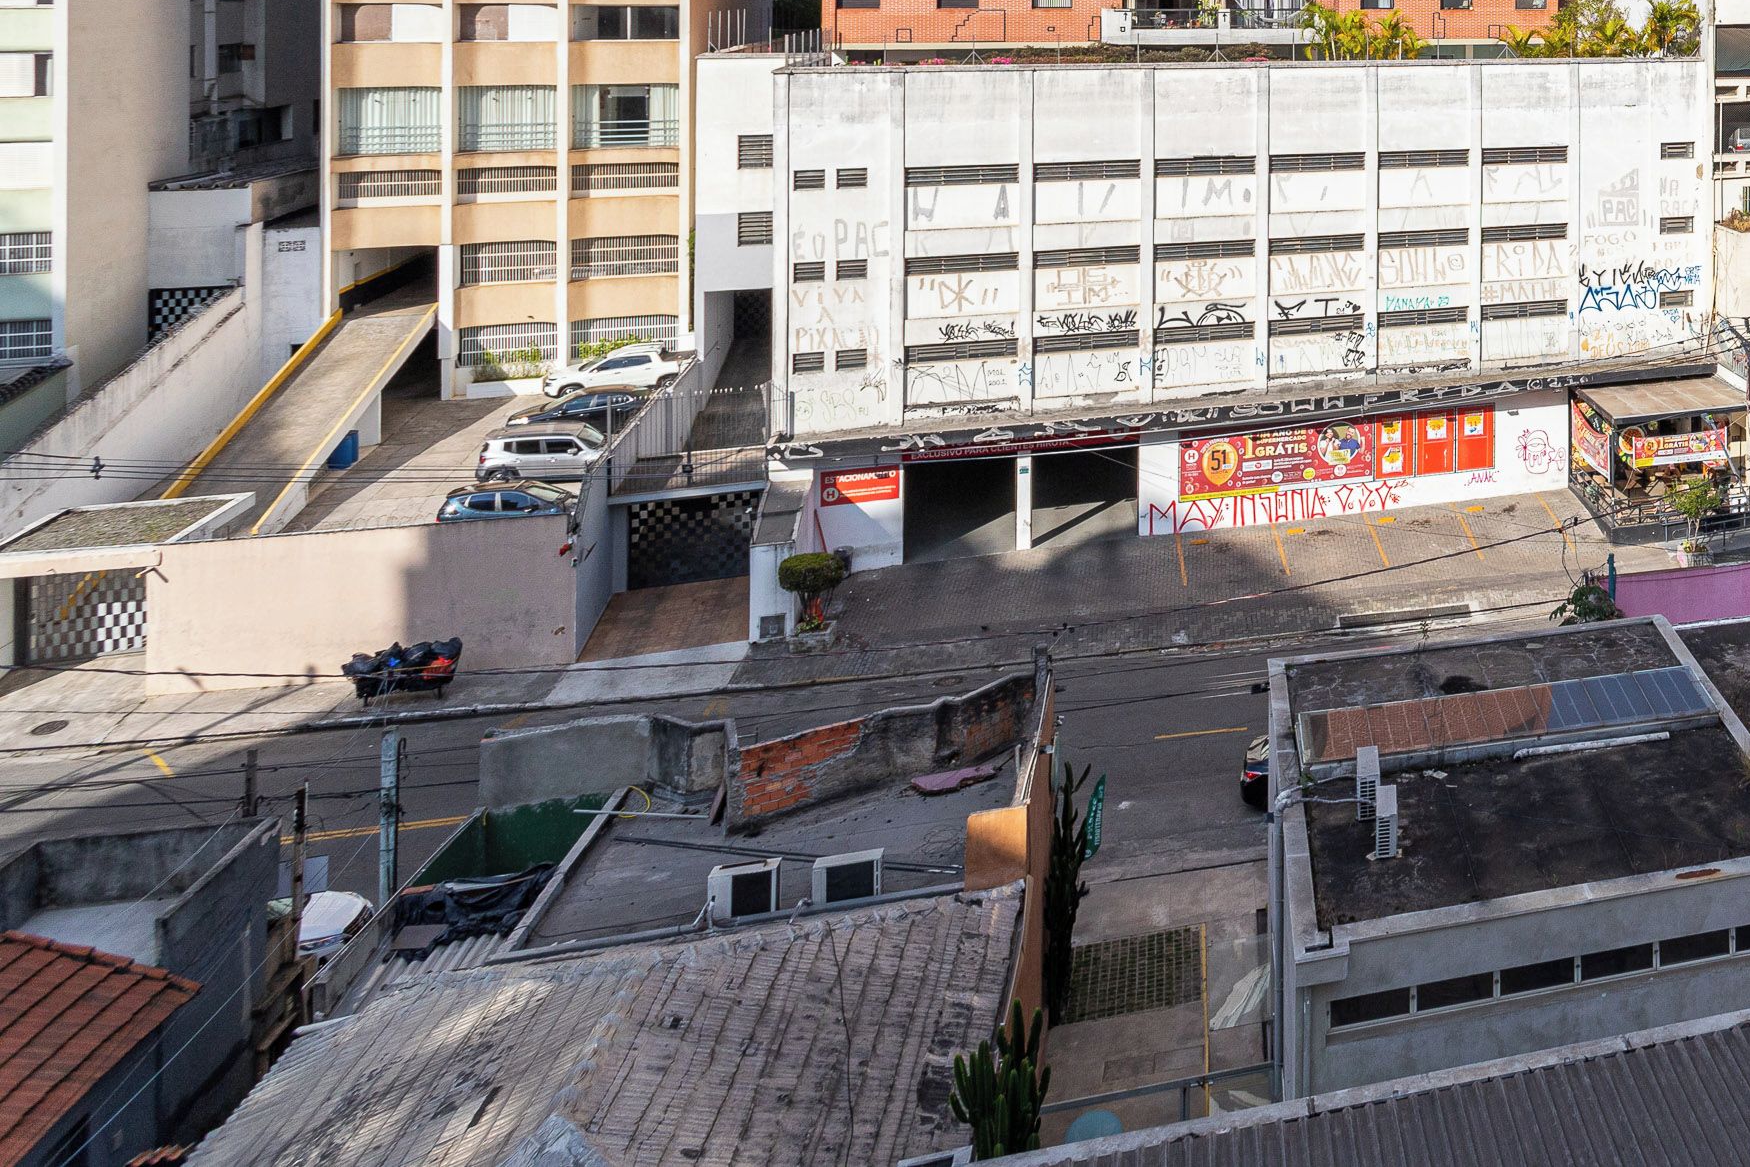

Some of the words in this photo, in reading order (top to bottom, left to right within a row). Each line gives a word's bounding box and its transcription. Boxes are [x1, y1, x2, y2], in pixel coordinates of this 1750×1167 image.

[911, 448, 963, 460] EXCLUSIVO
[964, 446, 989, 456] PARA
[990, 442, 1035, 454] CLIENTES
[1254, 442, 1308, 458] GRÁTIS
[1211, 449, 1226, 471] 51
